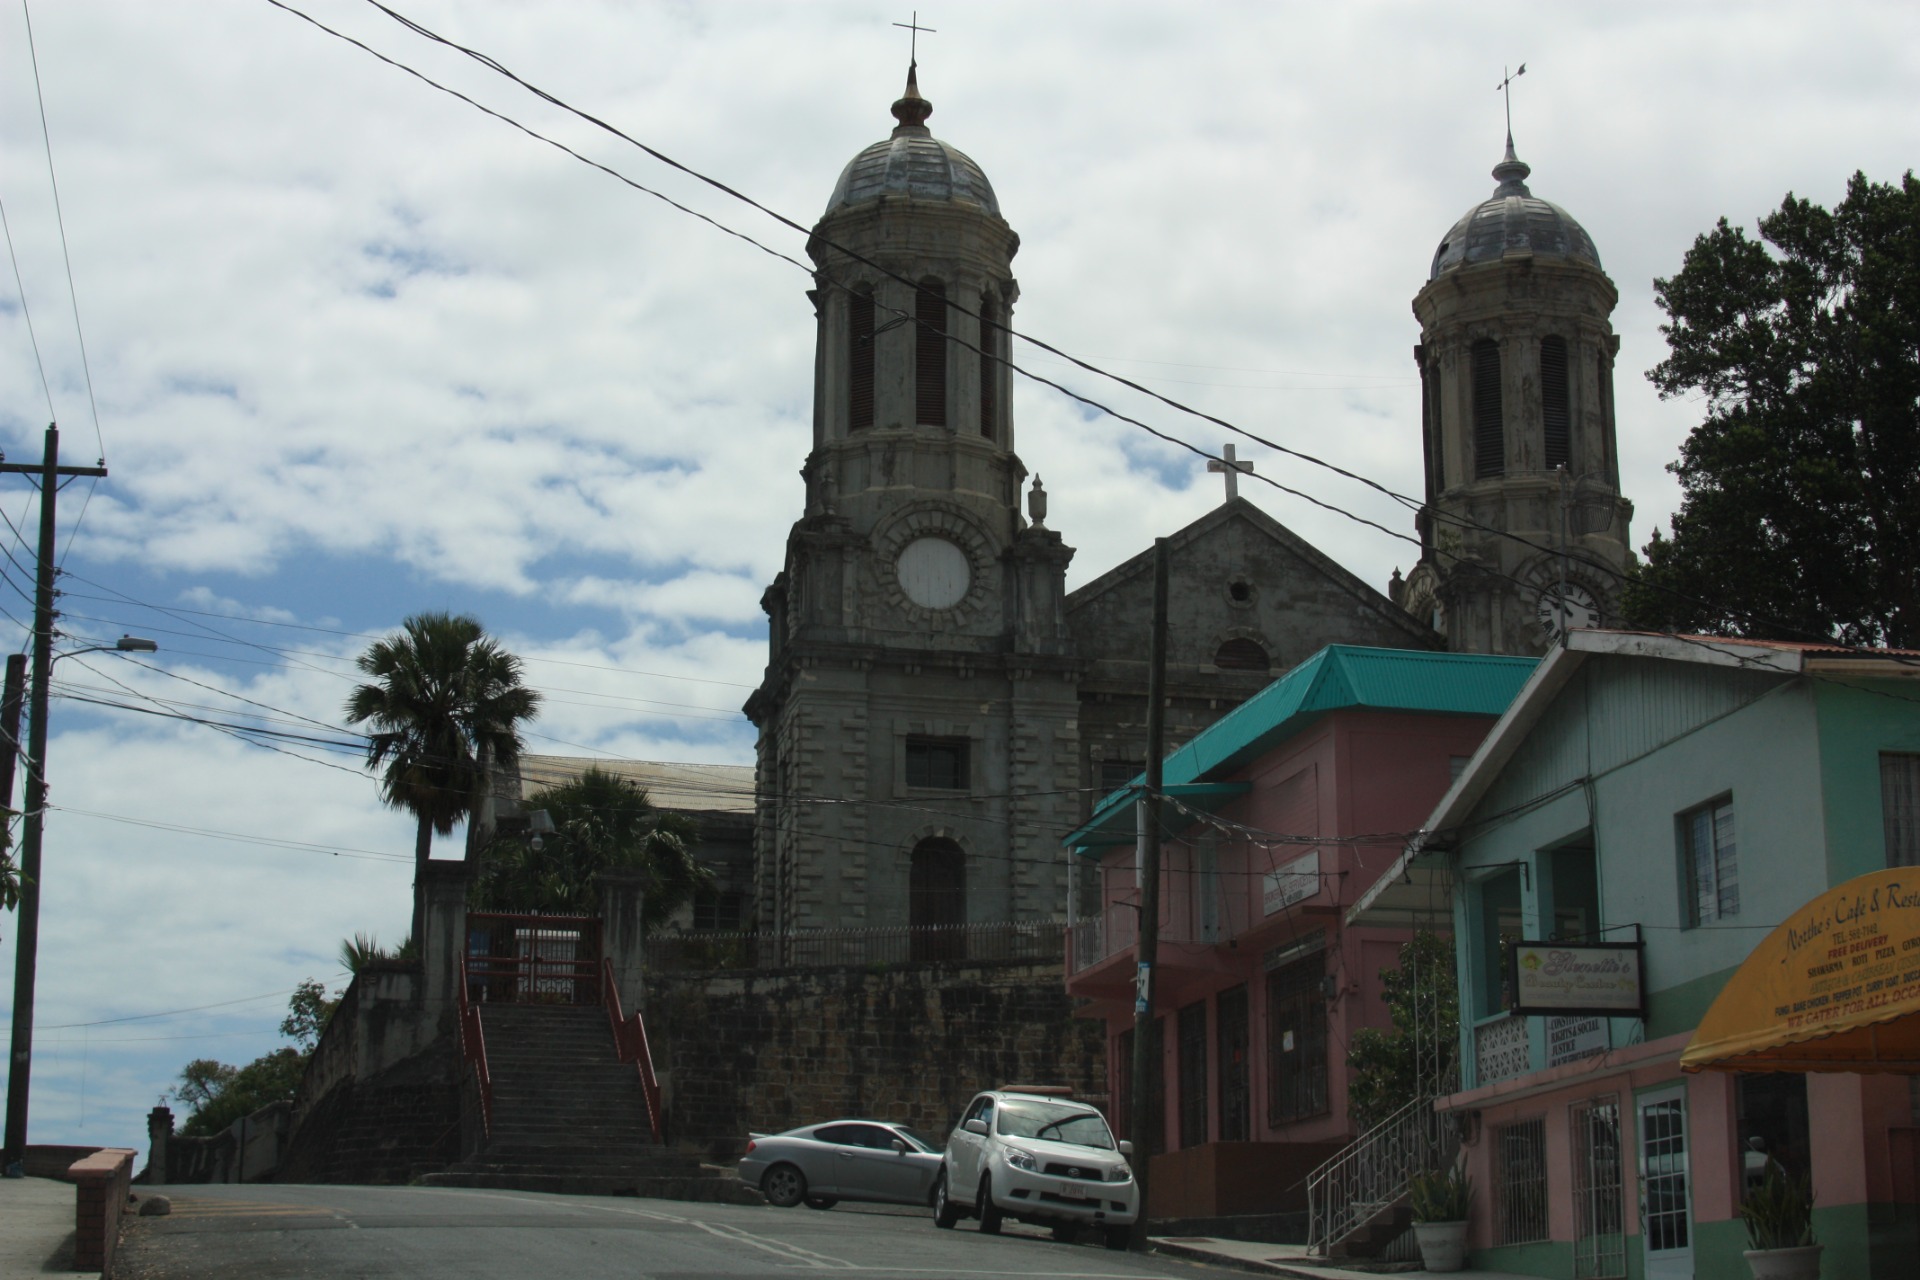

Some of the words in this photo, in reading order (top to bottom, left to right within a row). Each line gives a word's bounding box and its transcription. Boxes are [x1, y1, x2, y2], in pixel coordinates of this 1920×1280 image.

[1835, 895, 1866, 923] Café
[1870, 887, 1880, 912] &
[1827, 945, 1848, 960] FREE
[1849, 934, 1888, 954] DELIVERY
[1807, 961, 1843, 978] SHAWARMA
[1851, 954, 1868, 967] ROTI
[1875, 946, 1896, 960] PIZZA
[1787, 1015, 1803, 1029] WE
[1805, 1007, 1841, 1025] CATER
[1843, 999, 1865, 1016] FOR
[1866, 992, 1889, 1011] ALL
[1551, 1027, 1572, 1044] RIGHTS
[1572, 1025, 1577, 1037] &
[1577, 1018, 1600, 1035] SOCIAL
[1552, 1038, 1576, 1057] JUSTICE
